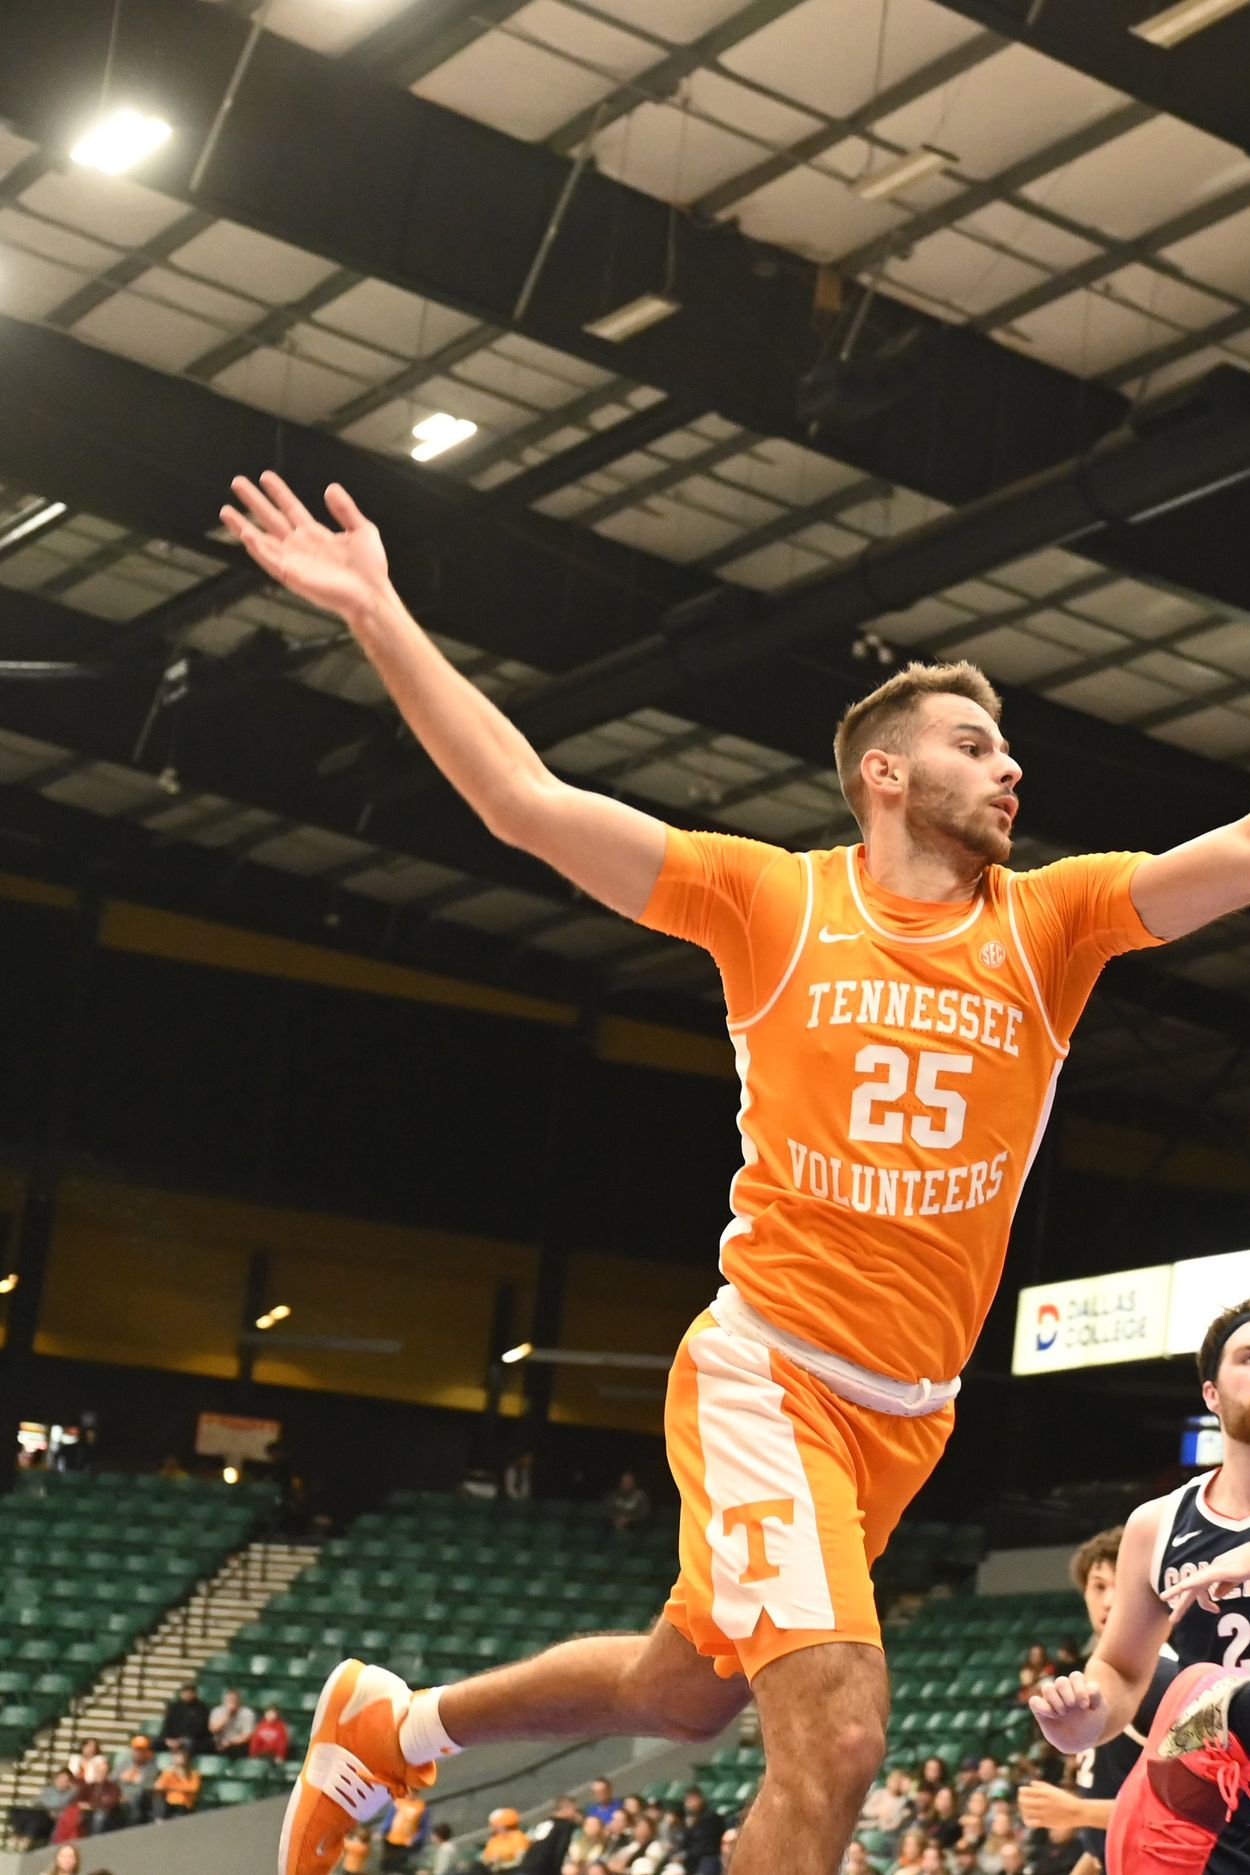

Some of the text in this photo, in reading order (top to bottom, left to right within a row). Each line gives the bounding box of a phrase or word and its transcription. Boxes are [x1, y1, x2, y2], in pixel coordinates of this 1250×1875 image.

[982, 943, 1004, 966] SEC
[806, 980, 1024, 1058] TENNESSEE
[848, 1044, 974, 1150] 25
[787, 1138, 1010, 1217] VOLUNTEERS
[1064, 1316, 1147, 1348] COLLEGE
[1066, 1290, 1137, 1320] DALLAS
[722, 1498, 794, 1585] T
